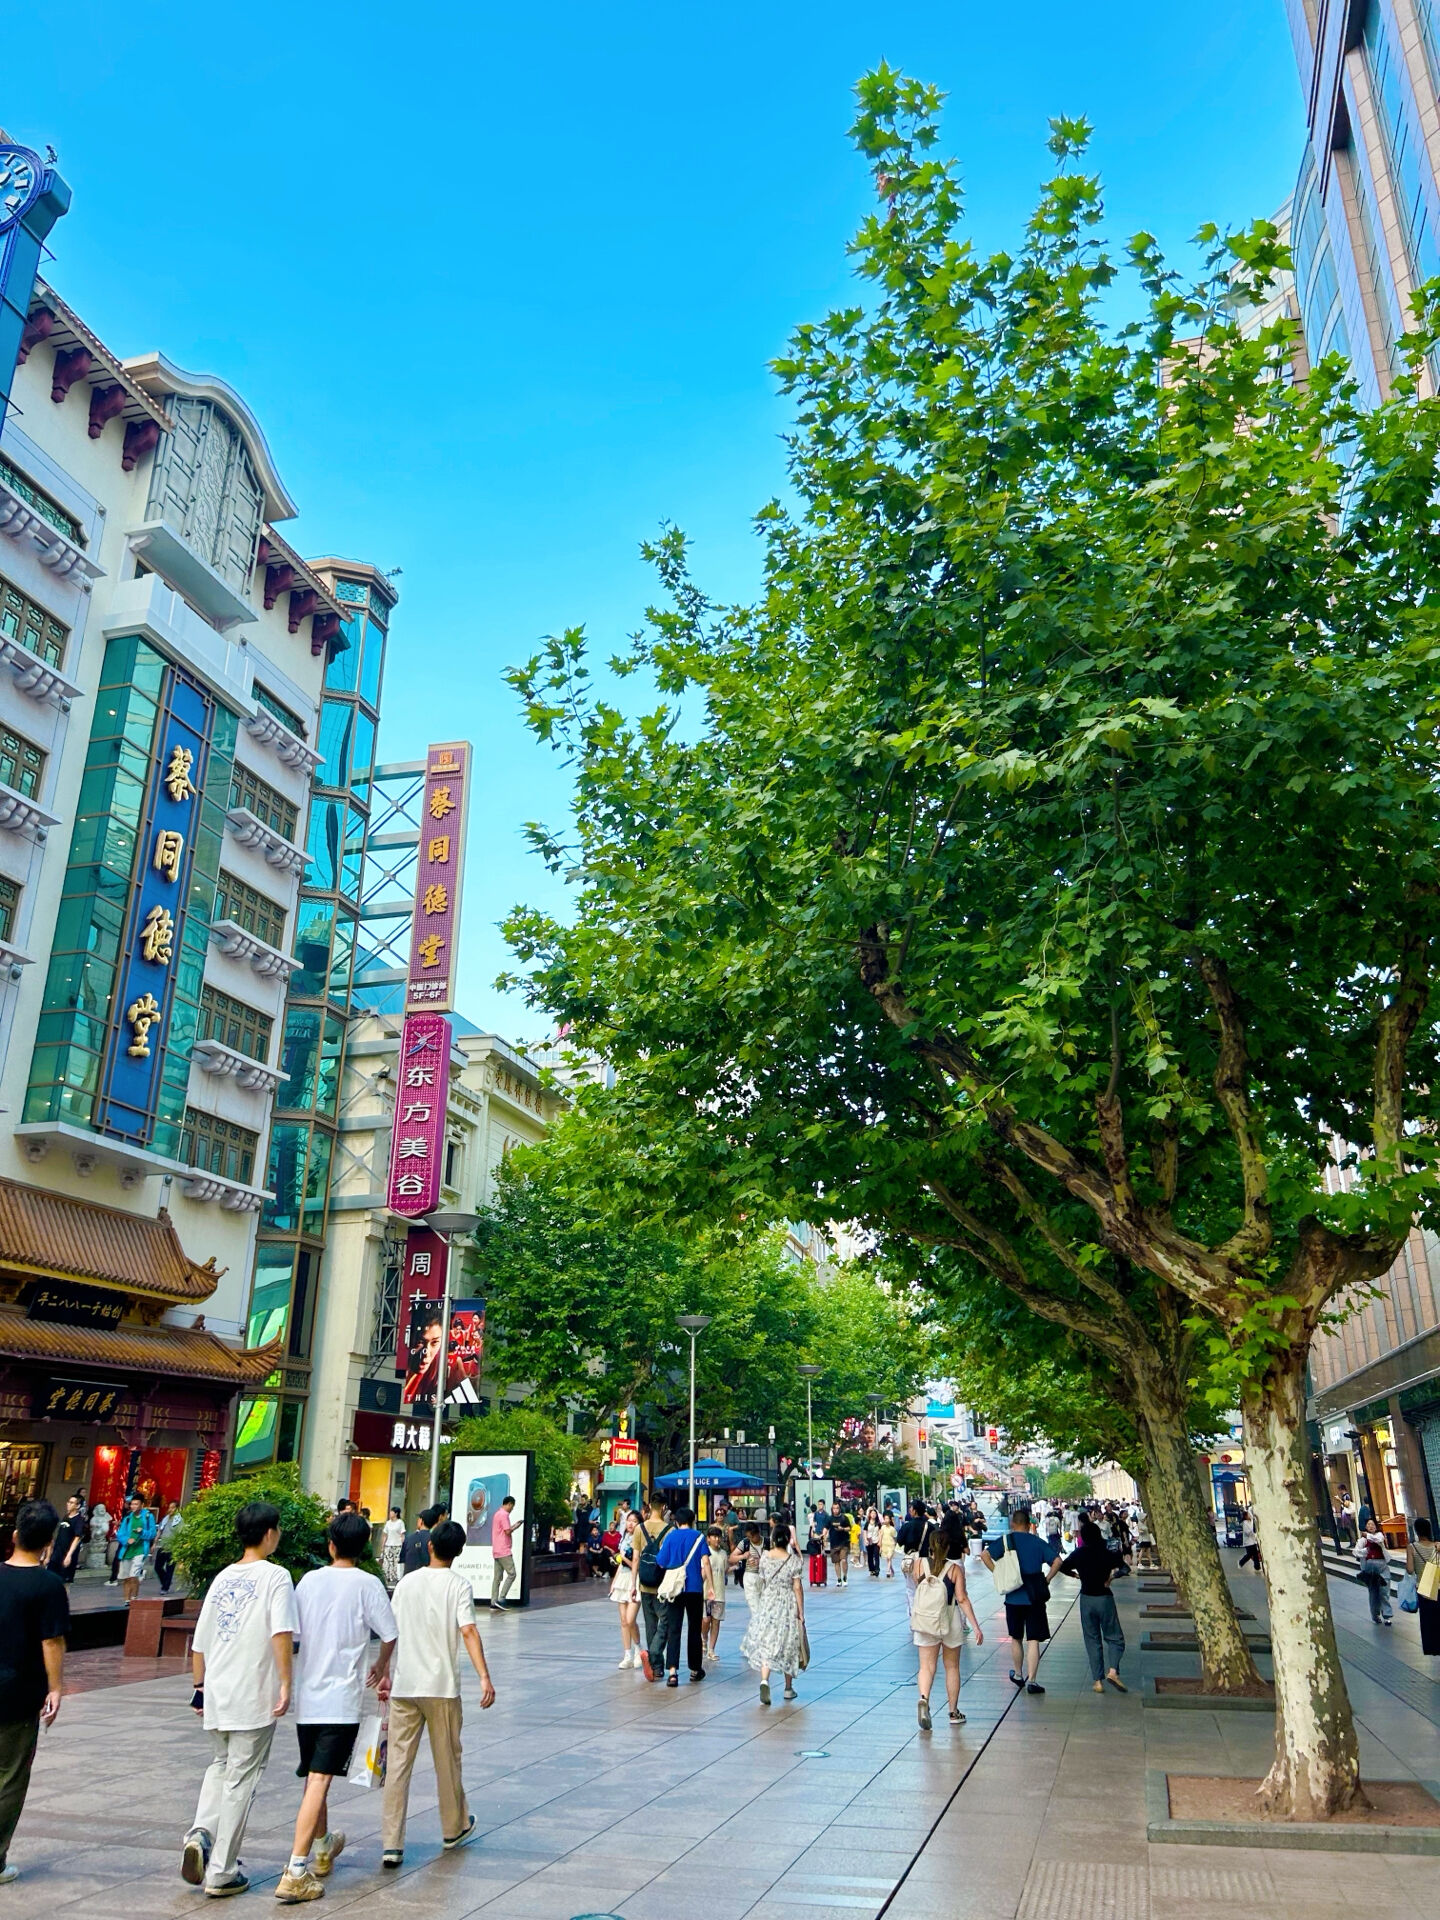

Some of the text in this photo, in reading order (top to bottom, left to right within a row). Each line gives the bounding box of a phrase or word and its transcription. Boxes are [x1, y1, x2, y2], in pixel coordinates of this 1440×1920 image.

[418, 785, 456, 970] 蔡同德堂
[127, 744, 197, 1058] 蔡同德堂
[395, 1065, 435, 1196] 东方美谷
[414, 1302, 444, 1310] YOU
[406, 1393, 437, 1402] THIS
[390, 1423, 431, 1451] 周大福
[686, 1478, 711, 1486] PLICE
